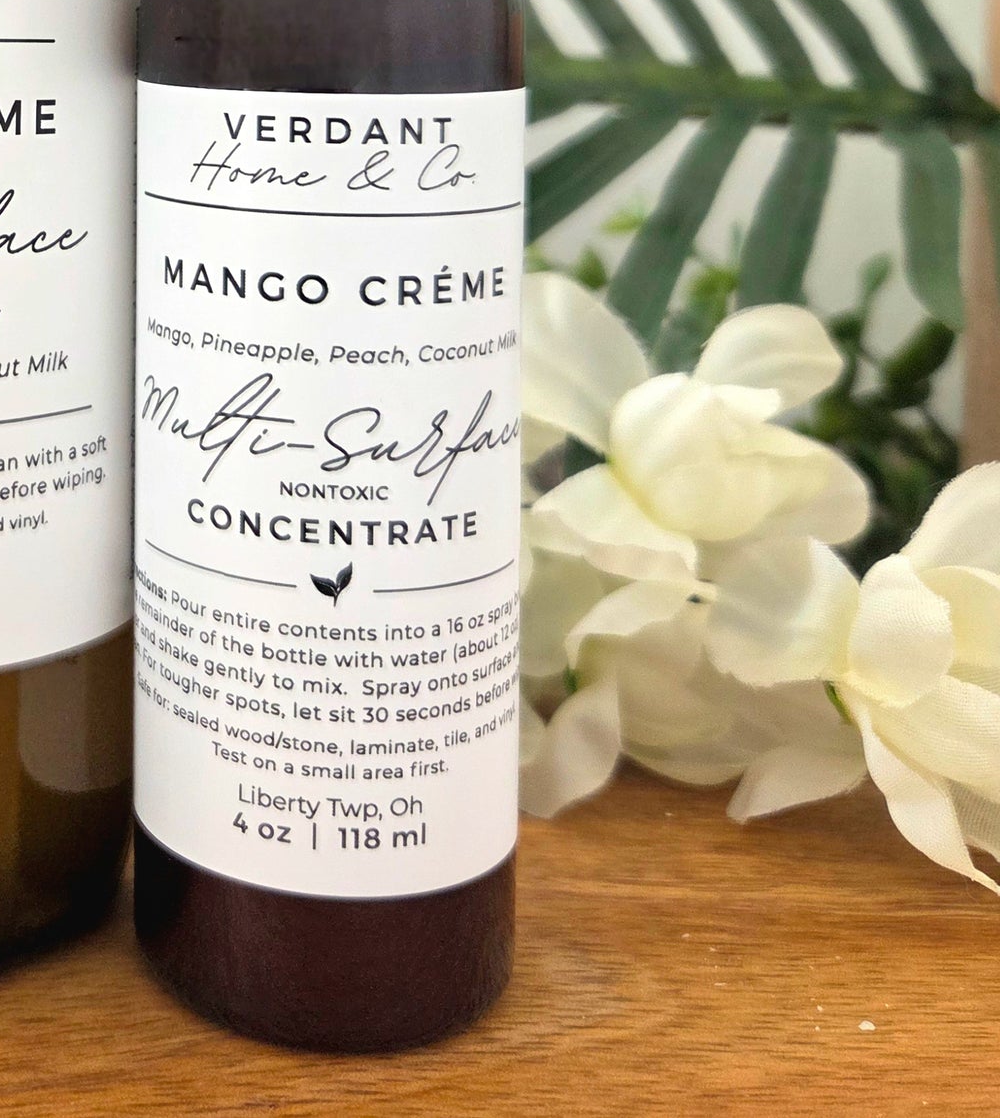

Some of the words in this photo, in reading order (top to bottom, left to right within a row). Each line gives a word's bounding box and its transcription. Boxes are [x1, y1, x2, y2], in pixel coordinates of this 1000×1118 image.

[223, 112, 452, 145] VERDANT
[190, 140, 327, 191] Home
[346, 150, 395, 191] &
[417, 144, 476, 191] Co.
[164, 255, 329, 305] MANGO
[359, 265, 504, 307] CRÉME
[27, 350, 68, 375] Milk
[147, 316, 194, 349] Mango,
[201, 332, 319, 366] Pineapple,
[329, 345, 410, 367] Peach,
[418, 339, 494, 363] Coconut
[497, 331, 516, 352] Milk
[25, 445, 63, 468] with
[68, 446, 77, 461] a
[81, 435, 107, 457] soft
[52, 467, 106, 491] wiping.
[280, 481, 389, 501] NONTOXIC
[9, 510, 48, 530] vinyl.
[187, 498, 477, 546] CONCENTRATE
[138, 594, 194, 638] remainder
[199, 630, 217, 646] of
[221, 635, 254, 657] the
[261, 642, 328, 667] bottle
[334, 651, 383, 668] with
[390, 649, 447, 668] water
[453, 632, 498, 664] (about
[501, 624, 509, 645] 12
[171, 590, 207, 617] Pour
[212, 609, 271, 633] entire
[278, 623, 378, 642] contents
[385, 624, 426, 641] into
[431, 624, 441, 637] a
[447, 616, 464, 634] 16
[468, 614, 485, 630] oz
[488, 600, 513, 625] spray
[140, 623, 156, 646] and
[158, 637, 199, 667] shake
[204, 659, 266, 689] gently
[272, 673, 295, 691] to
[303, 677, 348, 696] mix.
[362, 679, 422, 700] Spray
[427, 672, 468, 692] onto
[472, 651, 512, 682] surface
[140, 647, 157, 671] For
[159, 662, 220, 700] tougher
[225, 693, 286, 719] spots,
[293, 701, 322, 721] let
[329, 705, 356, 723] sit
[362, 706, 389, 724] 30
[395, 696, 471, 722] seconds
[475, 679, 510, 708] before
[153, 687, 170, 711] for:
[173, 704, 219, 733] sealed
[224, 723, 343, 757] wood/stone,
[350, 738, 439, 756] laminate,
[444, 729, 471, 747] tile,
[475, 716, 496, 738] and
[211, 740, 247, 765] Test
[253, 757, 277, 772] on
[283, 762, 294, 775] a
[301, 763, 355, 780] small
[362, 767, 404, 780] area
[409, 759, 449, 777] first.
[238, 783, 321, 820] Liberty
[326, 797, 383, 822] Twp,
[390, 795, 423, 817] Oh
[232, 811, 249, 834] 4
[258, 822, 291, 844] oz
[338, 827, 381, 850] 118
[392, 822, 426, 848] ml
